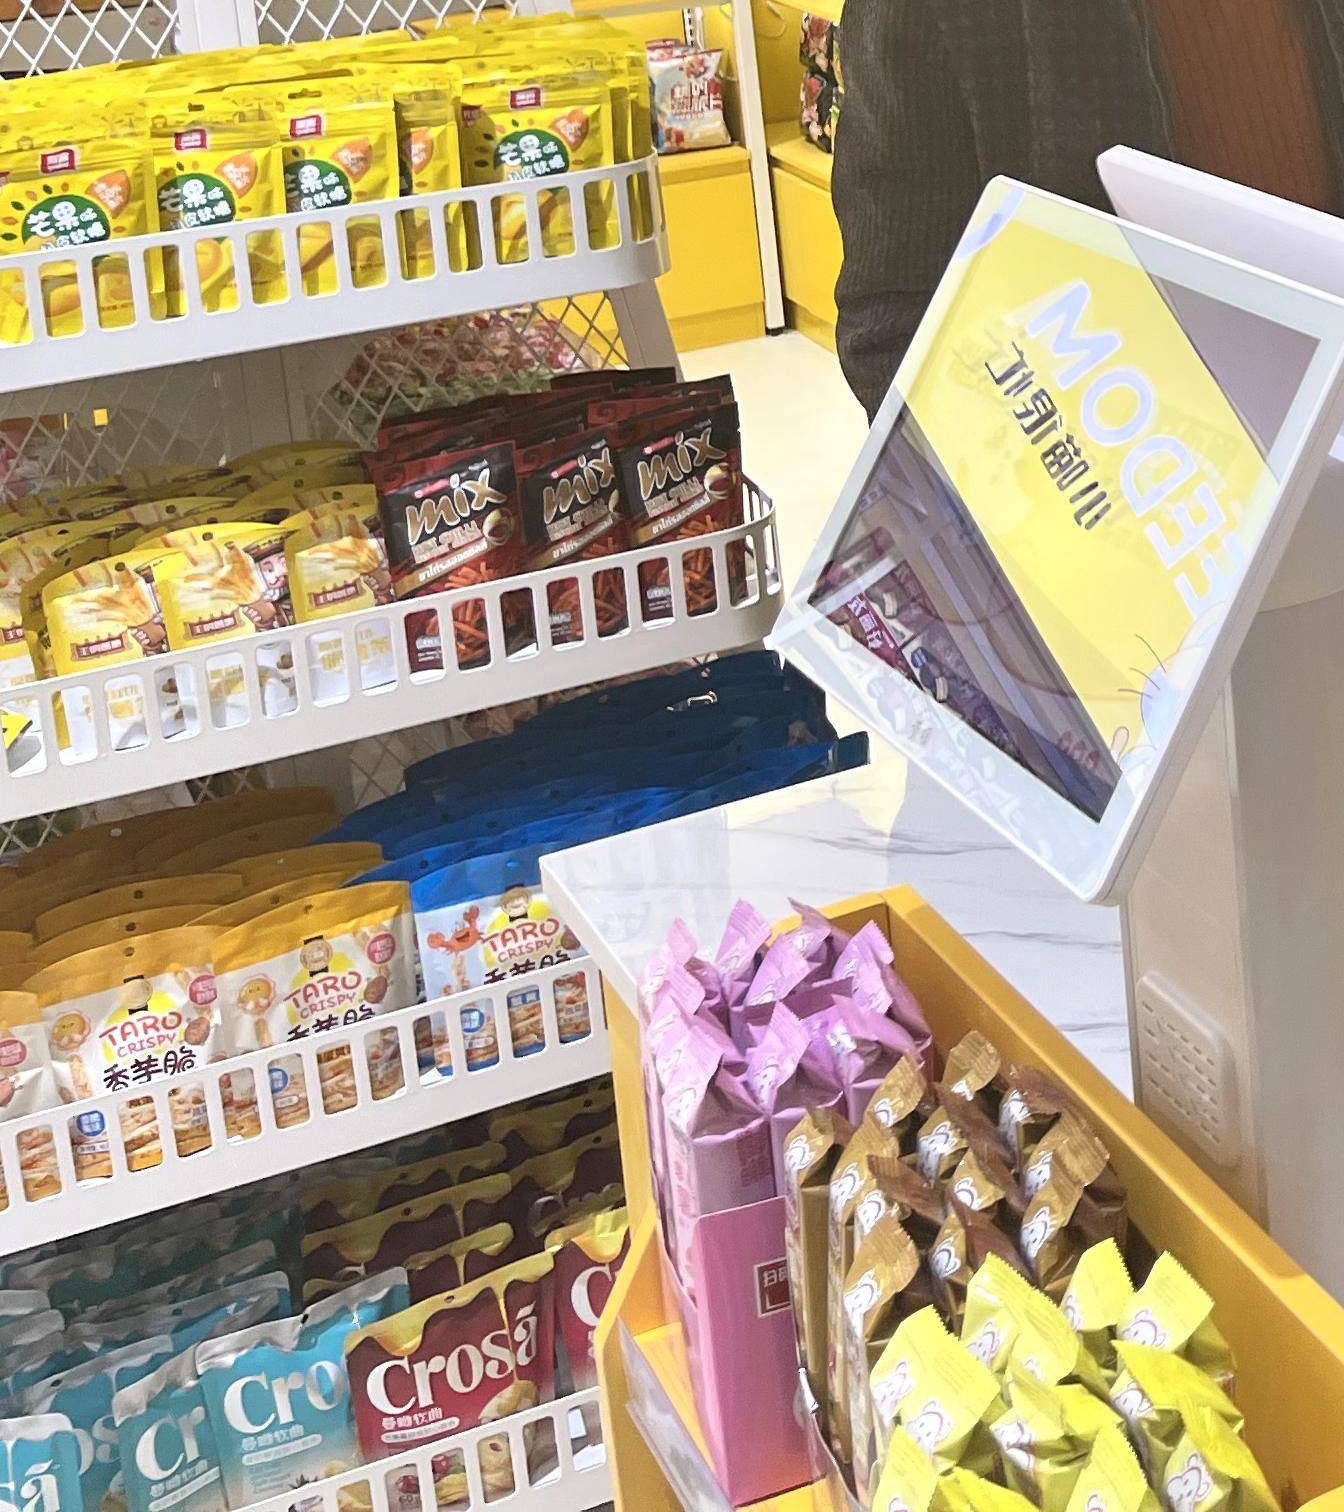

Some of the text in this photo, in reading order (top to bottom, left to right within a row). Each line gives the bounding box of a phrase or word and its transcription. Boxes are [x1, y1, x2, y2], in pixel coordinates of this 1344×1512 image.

[637, 427, 727, 500] mix
[543, 446, 616, 524] mix
[405, 467, 508, 546] mix
[481, 917, 560, 952] TARO
[496, 937, 555, 964] CRISPY
[282, 970, 363, 1009] TARO
[300, 991, 357, 1020] CRISPY
[98, 1011, 184, 1046] TARO
[116, 1032, 177, 1058] CRISPY
[366, 1301, 538, 1415] Crosá
[223, 1360, 345, 1435] Cro
